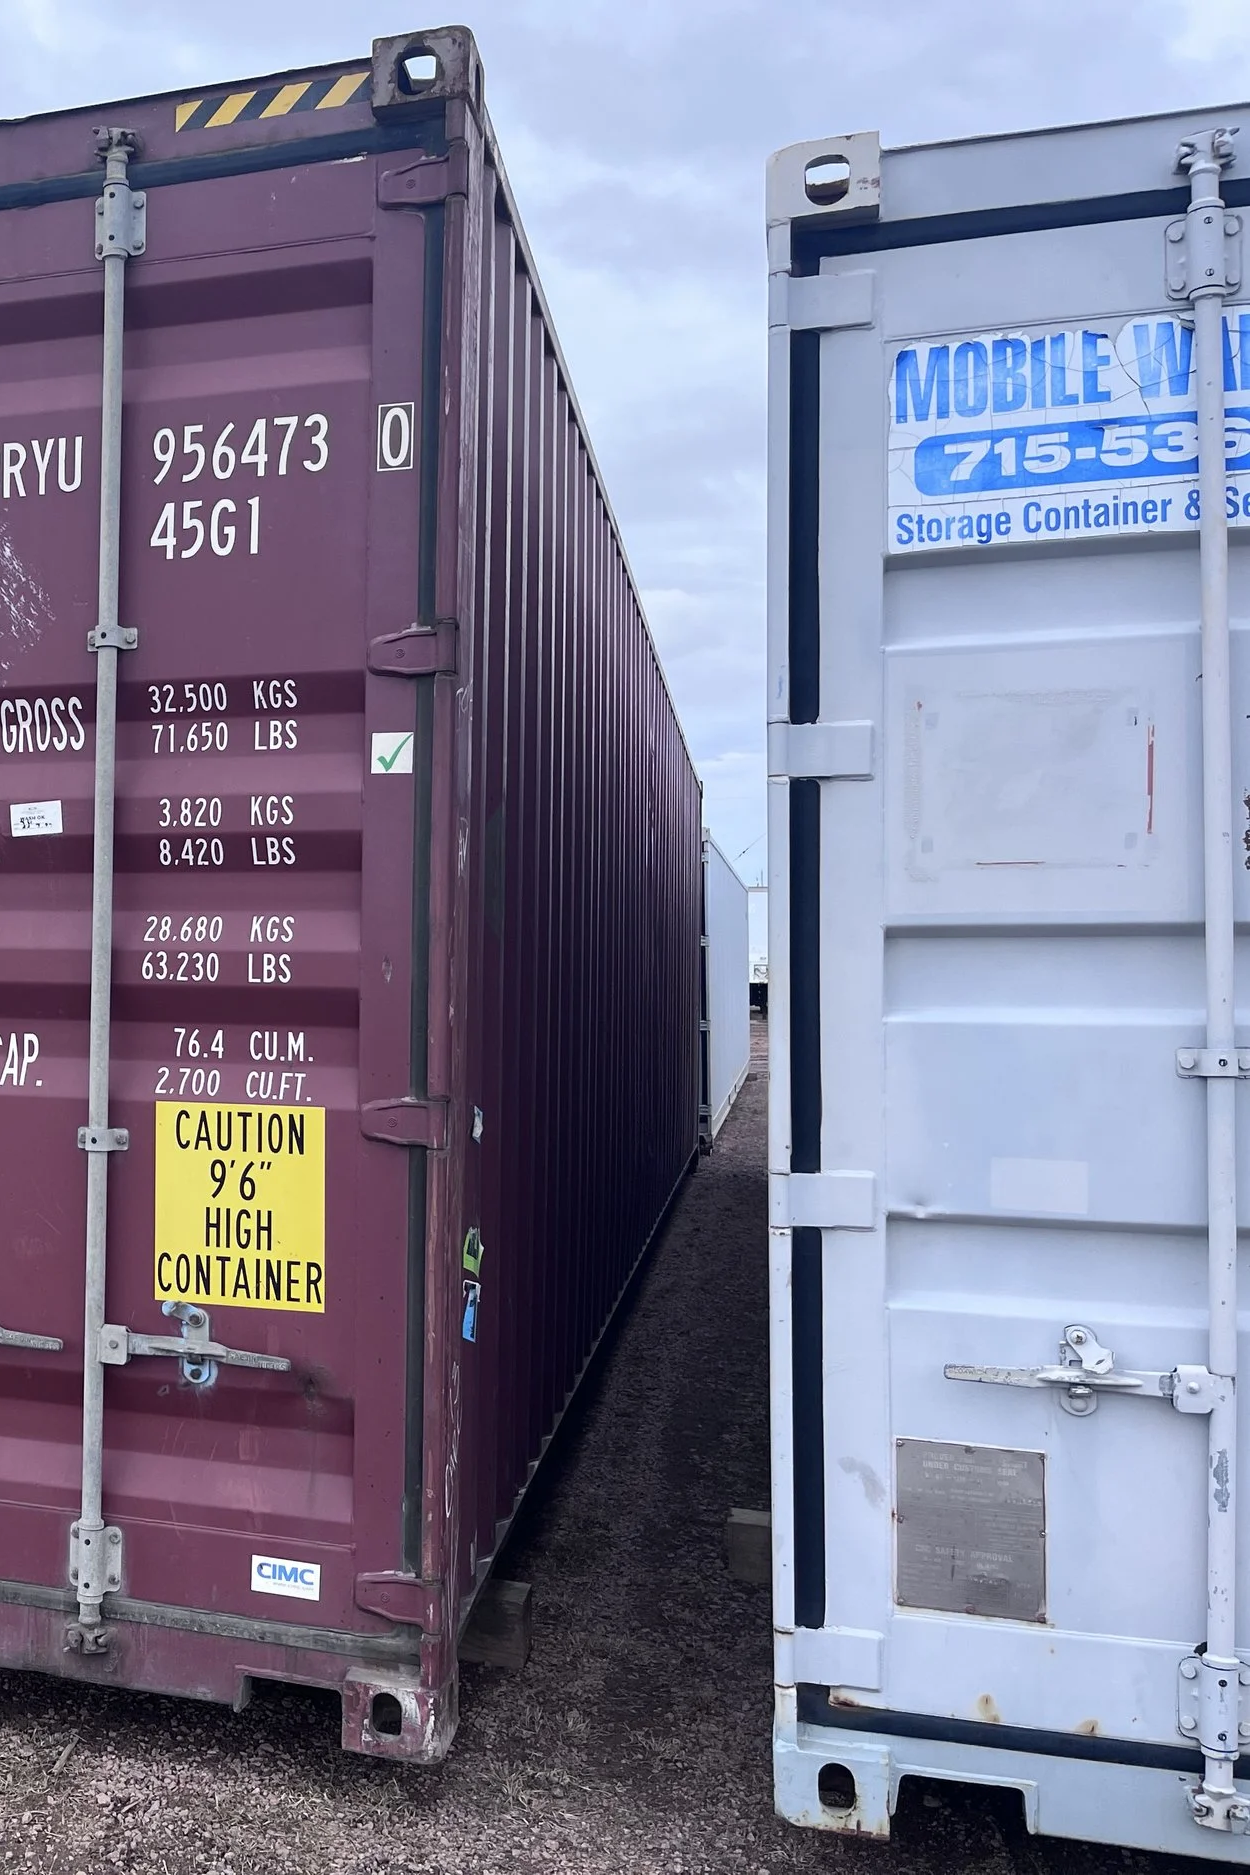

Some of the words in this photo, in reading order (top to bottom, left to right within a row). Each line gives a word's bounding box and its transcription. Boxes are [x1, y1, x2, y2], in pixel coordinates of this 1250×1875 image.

[896, 329, 1110, 424] MOBILE
[153, 413, 329, 486] 956473
[381, 407, 411, 467] 0
[150, 496, 260, 560] 45G1
[896, 511, 1011, 544] Storage
[1024, 495, 1172, 534] Container
[148, 682, 228, 713] 32.500
[252, 679, 299, 710] KGS
[151, 721, 228, 754] 71.650
[254, 719, 299, 751] LBS
[158, 797, 223, 828] 3.820
[250, 795, 296, 826] KGS
[159, 837, 225, 867] 8.420
[251, 836, 297, 866] LBS
[143, 915, 224, 943] 28.680
[249, 915, 296, 943] KGS
[141, 952, 220, 983] 63.230
[248, 953, 292, 984] LBS
[173, 1027, 225, 1060] 76.4
[249, 1030, 315, 1063] CU.M.
[154, 1066, 221, 1098] 2.700
[245, 1070, 313, 1102] CU.FT.
[175, 1109, 306, 1156] CAUTION
[205, 1206, 273, 1252] HIGH
[156, 1252, 323, 1306] CONTAINER
[256, 1562, 314, 1586] CIMC
